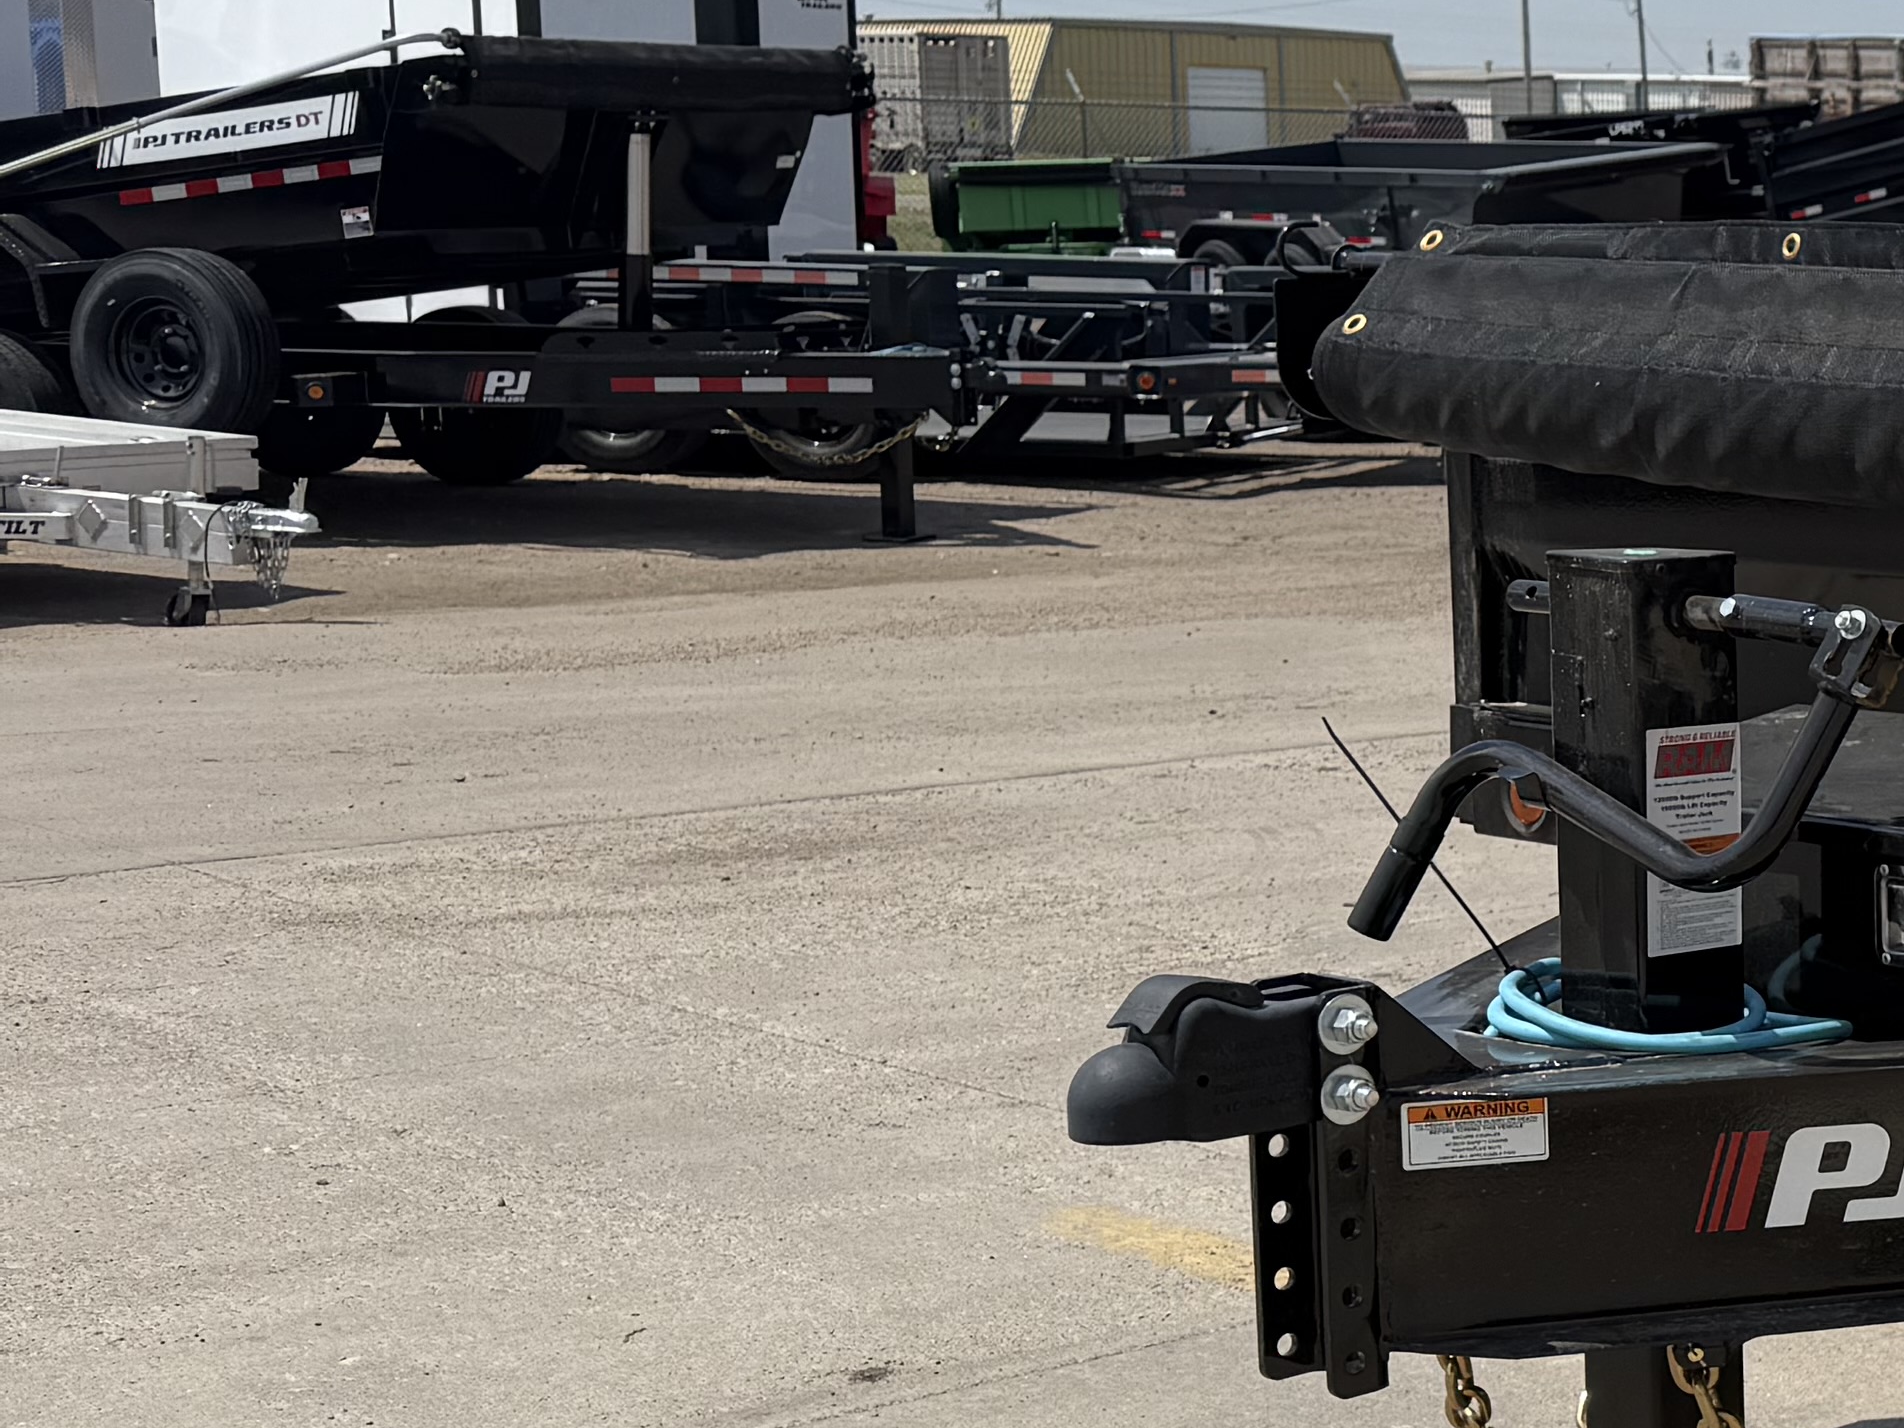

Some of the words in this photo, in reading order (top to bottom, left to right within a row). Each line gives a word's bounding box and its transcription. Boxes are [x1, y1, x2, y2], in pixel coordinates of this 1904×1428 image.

[170, 116, 292, 145] TRAILERS
[296, 111, 323, 128] DT
[484, 370, 532, 395] PJ
[1445, 1100, 1530, 1118] WARNING
